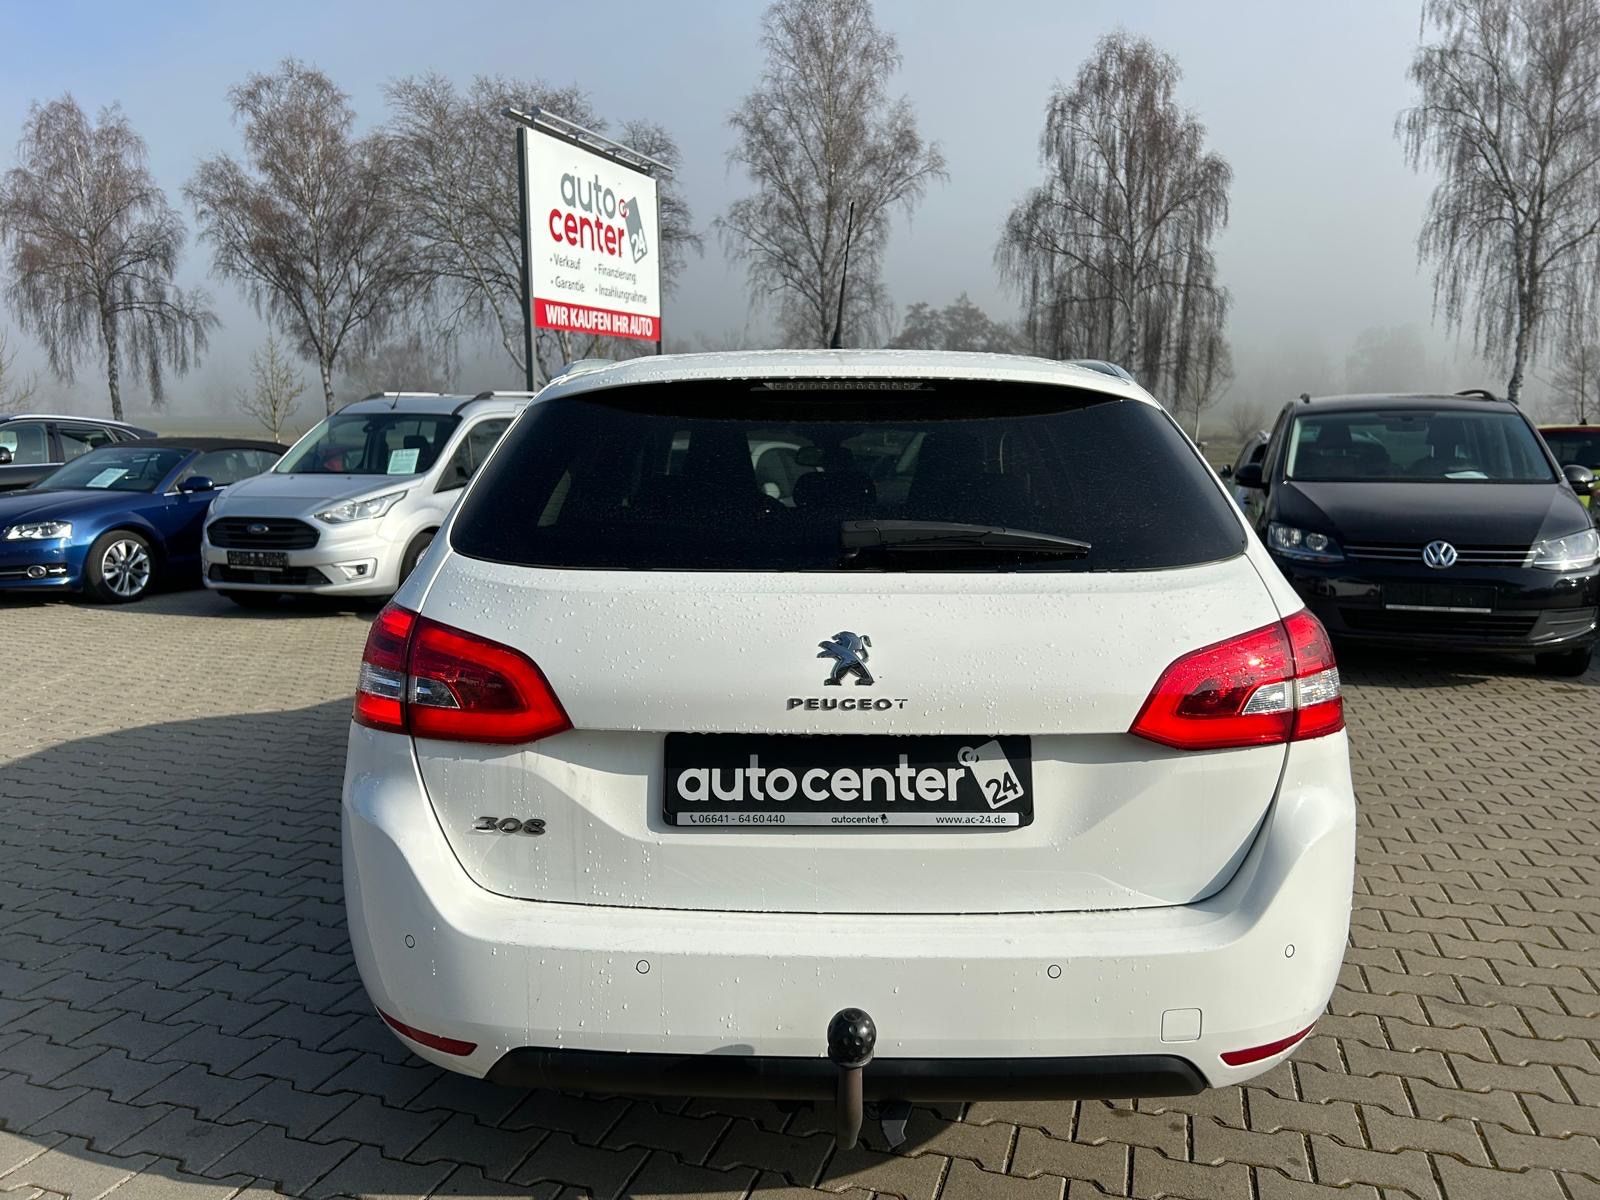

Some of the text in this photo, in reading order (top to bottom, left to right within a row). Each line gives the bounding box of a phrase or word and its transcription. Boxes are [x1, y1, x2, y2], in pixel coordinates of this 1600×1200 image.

[560, 172, 617, 220] auto
[549, 208, 625, 258] center
[553, 253, 581, 270] Verkauf
[555, 275, 585, 292] Garantie
[598, 263, 636, 285] Finanzierung
[545, 303, 653, 337] WIR KAUFEN IHR AUTO
[786, 697, 908, 712] PEUGEOT
[677, 753, 965, 801] autocenter
[985, 771, 1020, 805] 24
[475, 816, 546, 835] 308
[698, 814, 729, 824] 06641
[831, 815, 879, 824] autocenter
[935, 815, 1007, 824] www.ac-24.de
